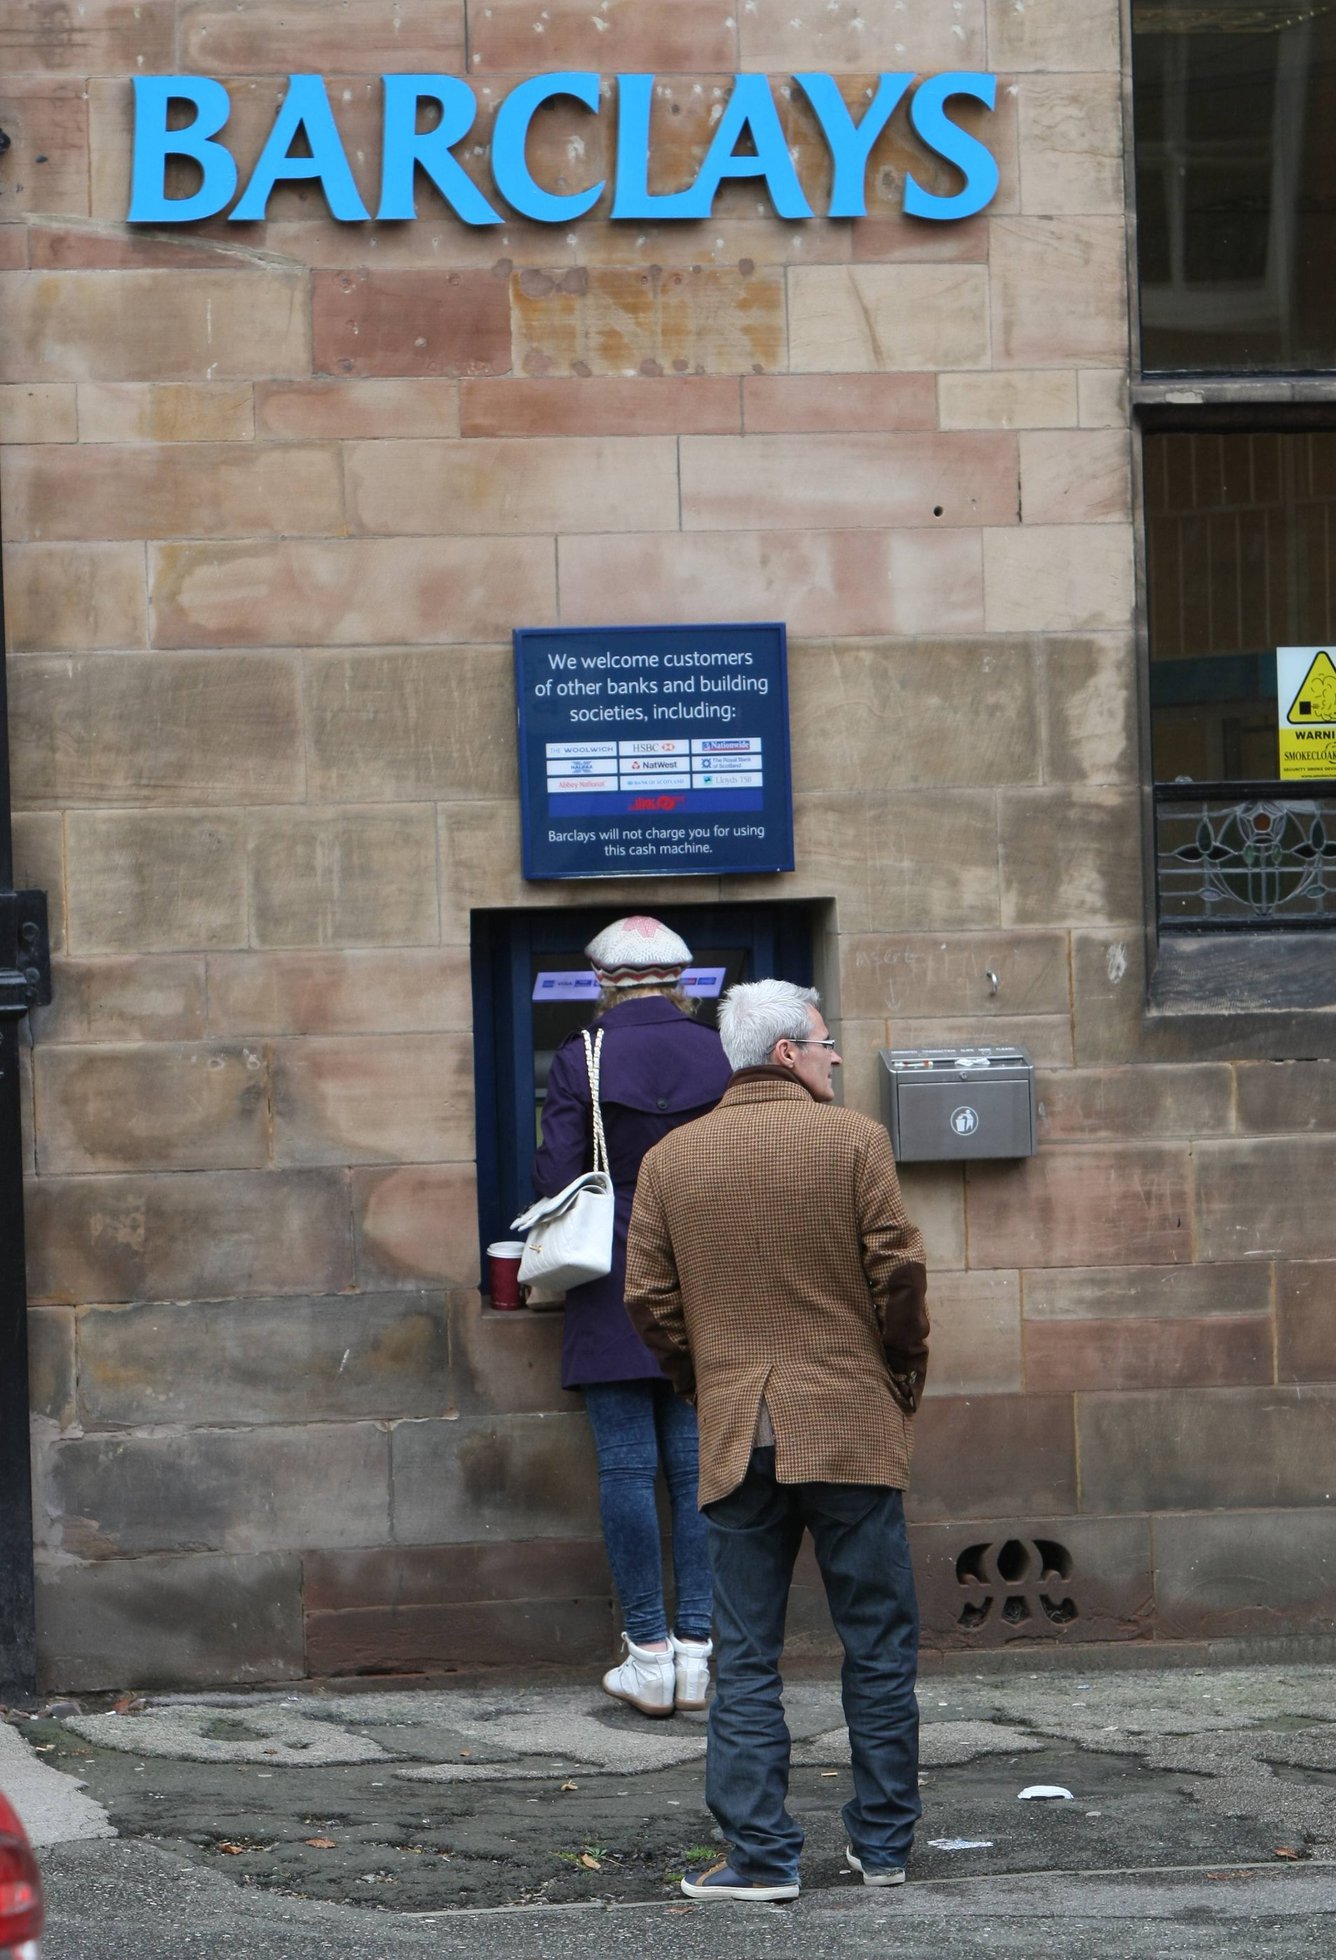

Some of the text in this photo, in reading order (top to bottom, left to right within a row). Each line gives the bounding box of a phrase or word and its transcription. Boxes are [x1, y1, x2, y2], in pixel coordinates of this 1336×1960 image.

[127, 71, 1000, 226] BARCLAYS
[548, 651, 753, 670] We welcome customers
[534, 674, 768, 696] of other banks and building
[569, 701, 736, 722] societies, including:
[633, 743, 659, 753] HSBC
[642, 761, 678, 770] NatWest
[548, 824, 765, 844] Barclays will not charge you for using
[604, 842, 713, 856] this cash machine.
